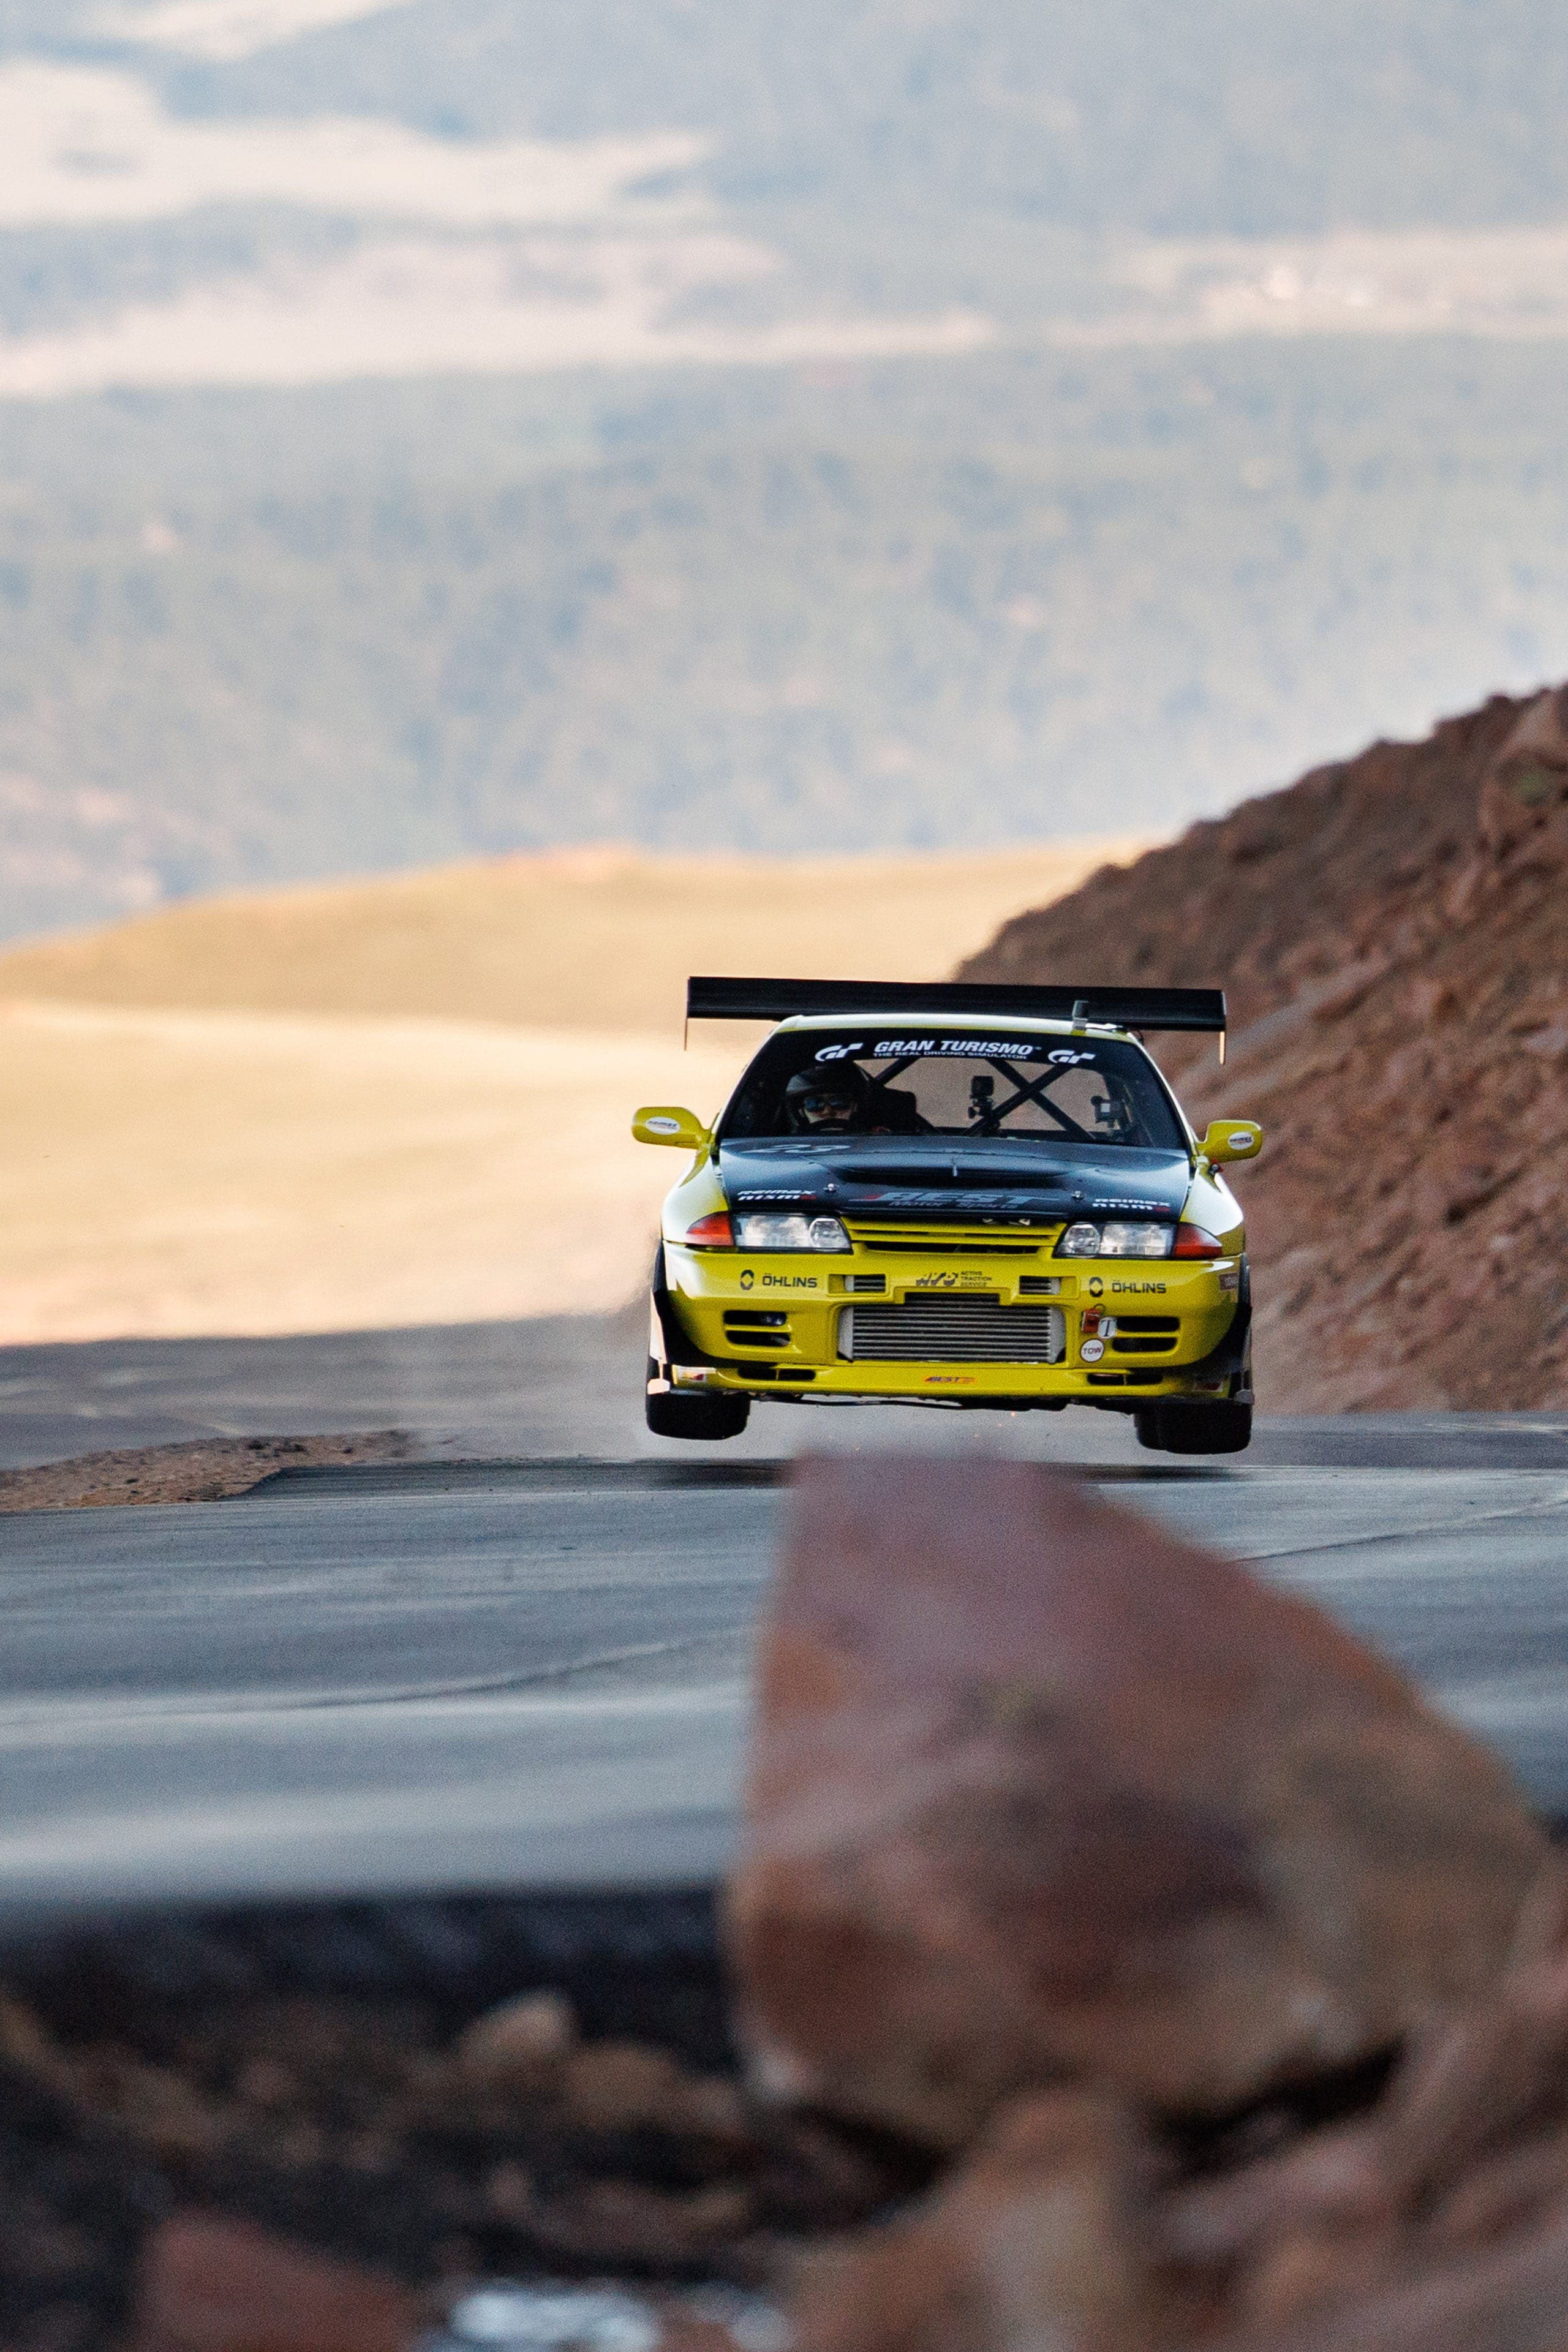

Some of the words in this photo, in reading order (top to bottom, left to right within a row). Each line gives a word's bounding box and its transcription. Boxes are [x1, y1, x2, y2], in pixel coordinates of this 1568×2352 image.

[874, 1041, 935, 1052] GRAN
[940, 1040, 1033, 1055] TURISMO
[873, 1192, 1060, 1204] BEST
[762, 1273, 818, 1288] ÖHLINS
[1112, 1280, 1166, 1294] ÖHLINS
